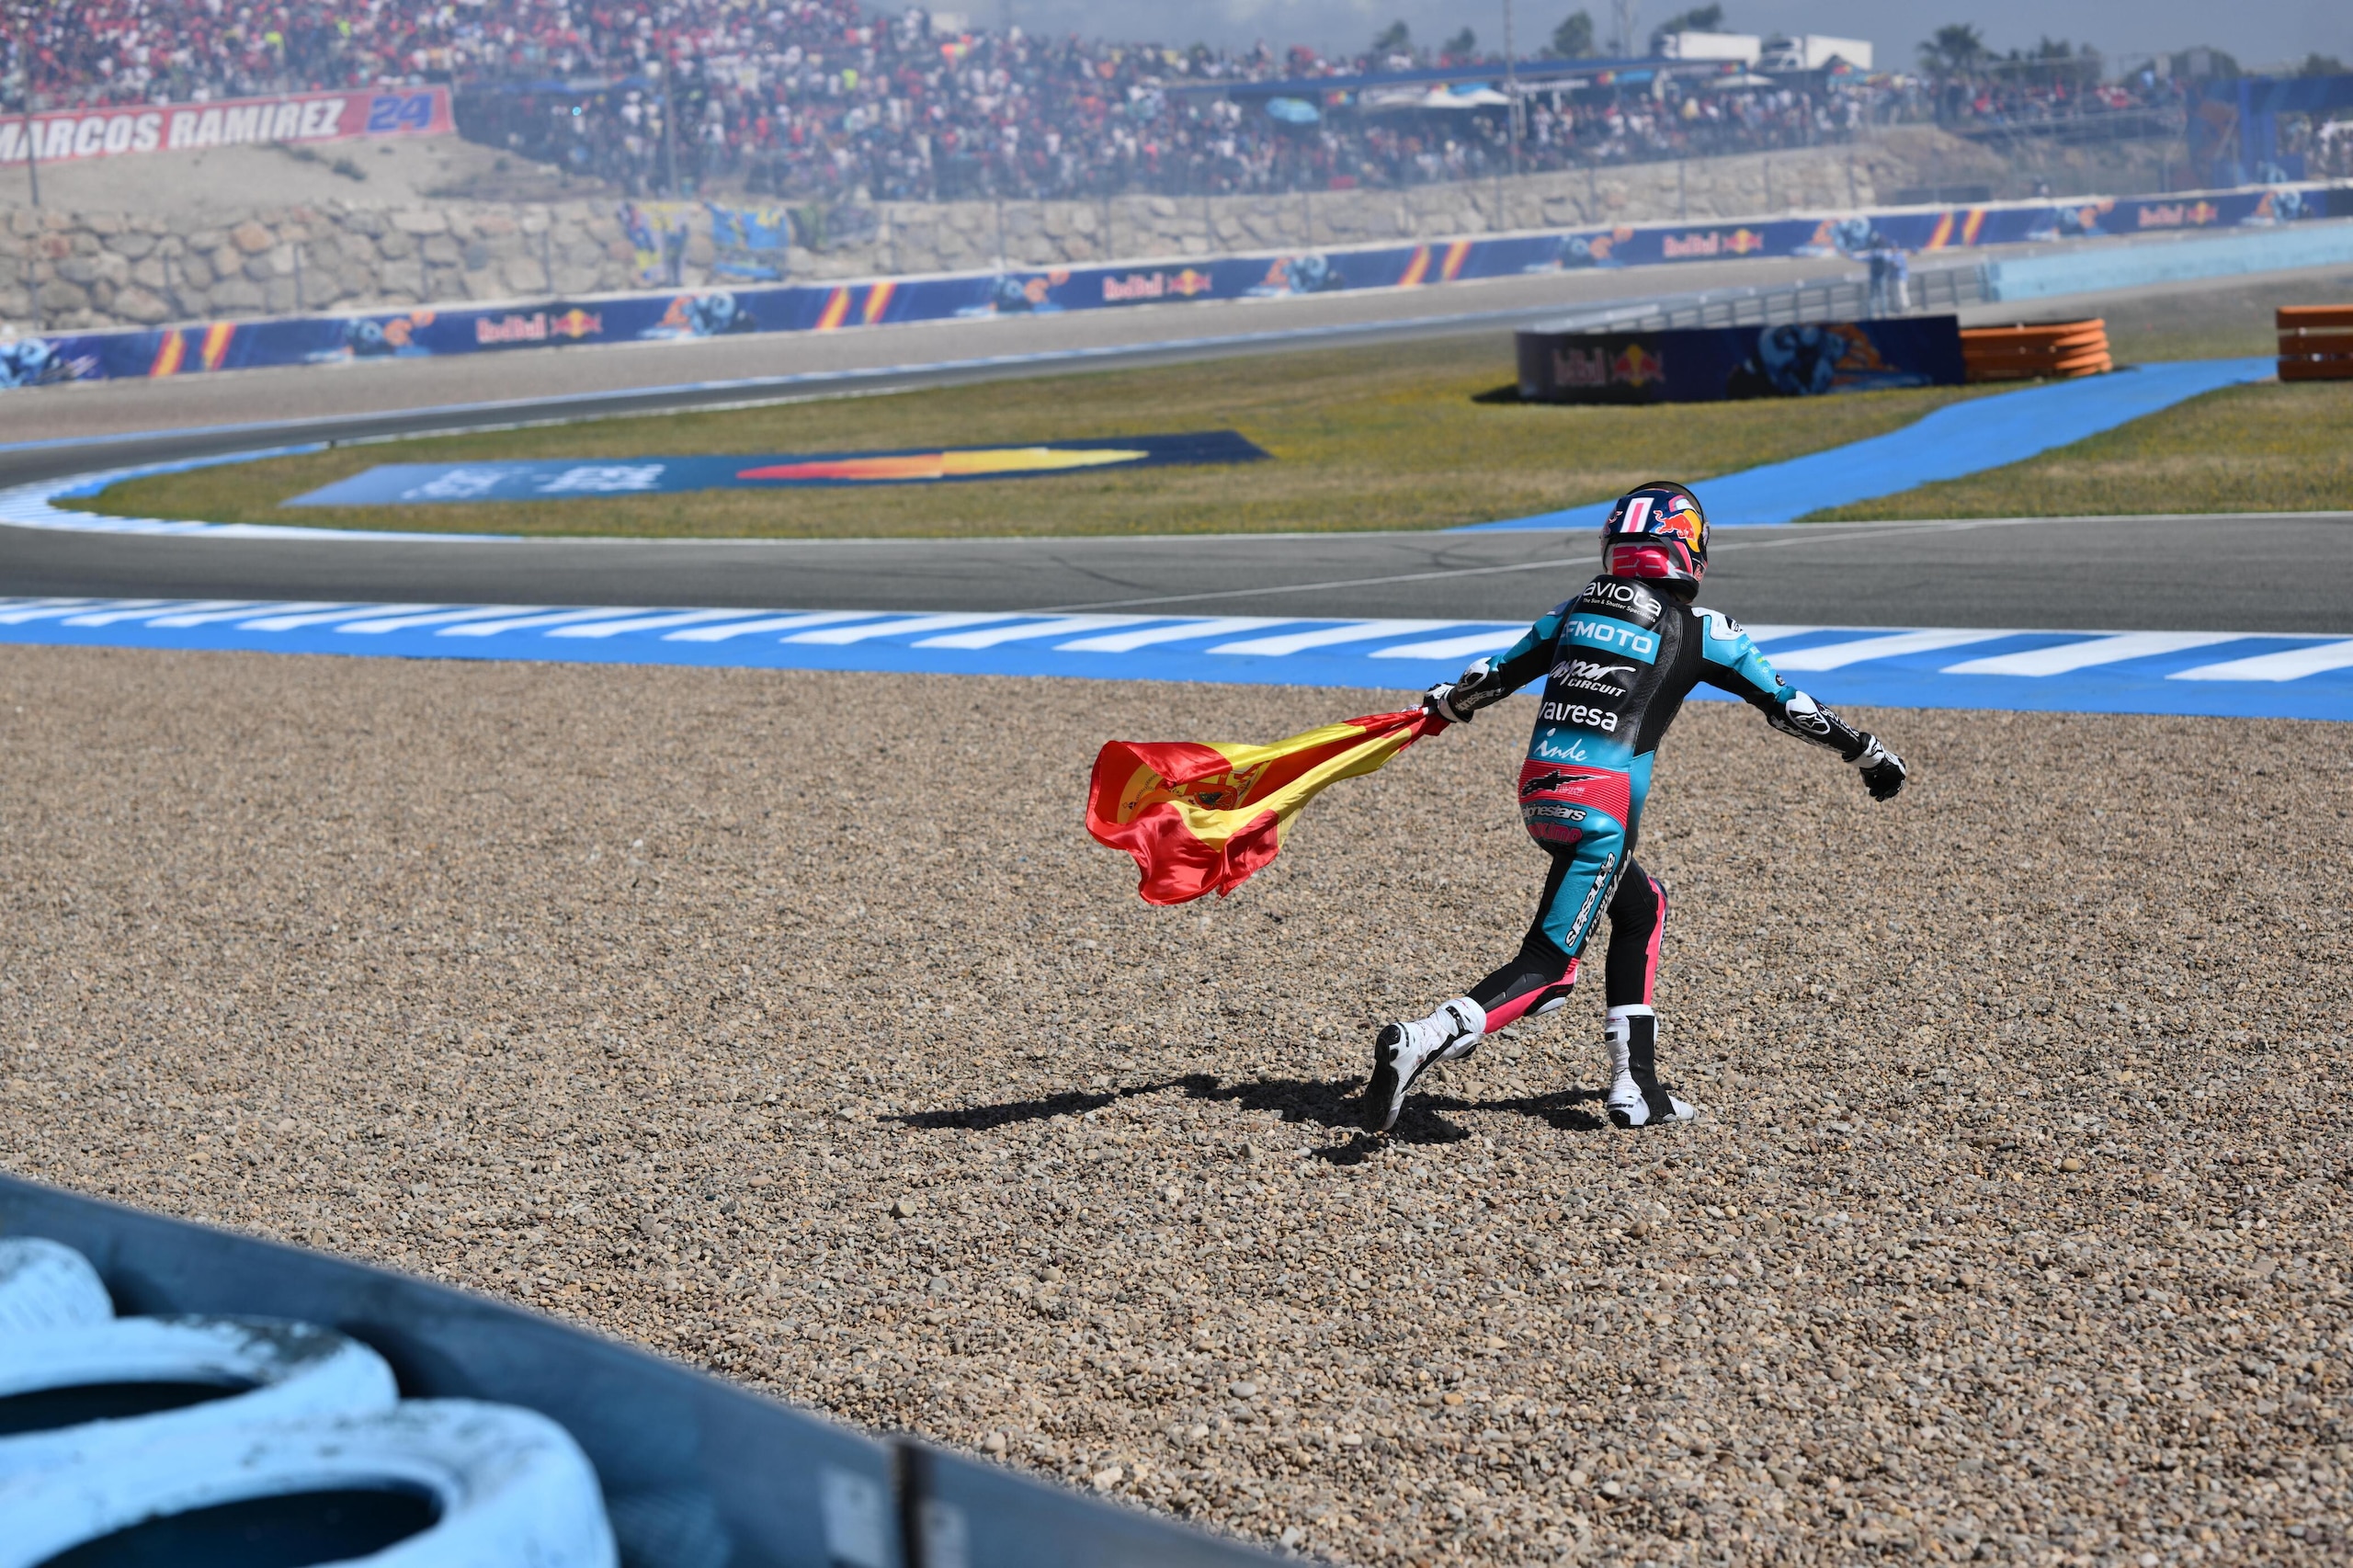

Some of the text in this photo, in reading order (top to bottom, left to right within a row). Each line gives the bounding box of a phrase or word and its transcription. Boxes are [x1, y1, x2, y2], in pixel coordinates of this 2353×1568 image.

[0, 94, 434, 163] MARCOS RAMIREZ 24
[1606, 599, 1626, 610] Shutter
[1627, 606, 1656, 623] Specialists
[1567, 678, 1626, 697] CIRCUIT
[1533, 728, 1587, 762] inde
